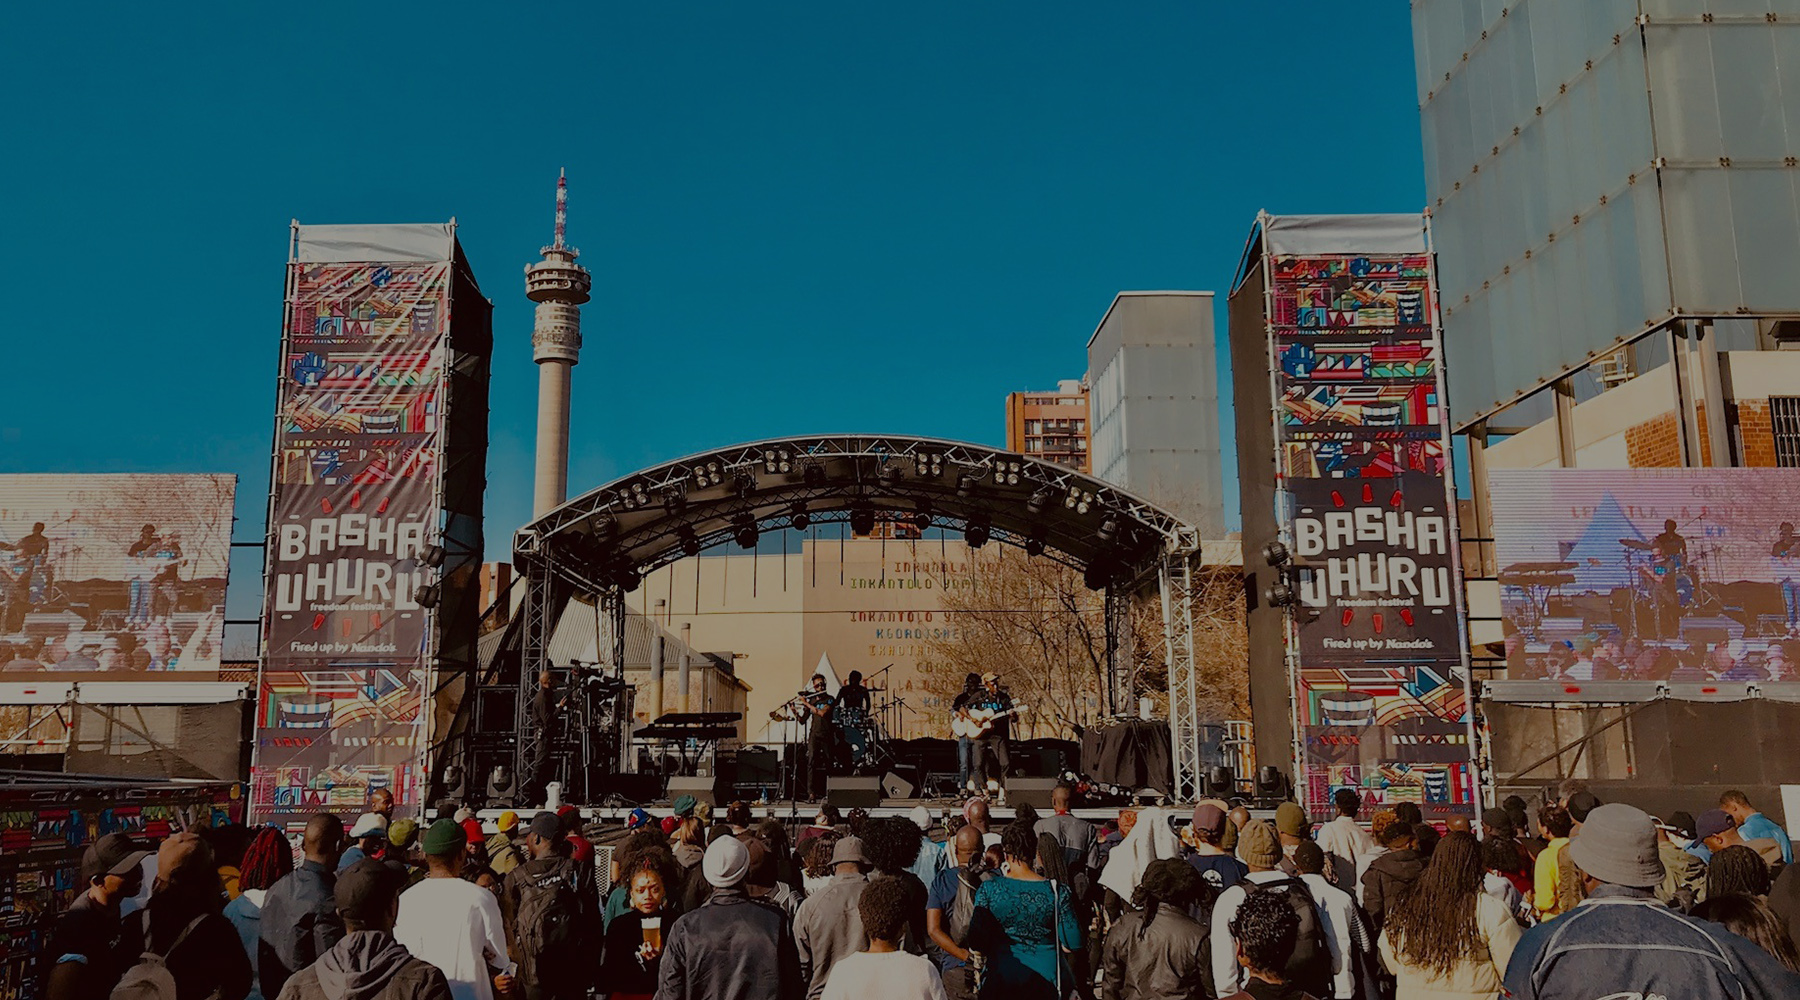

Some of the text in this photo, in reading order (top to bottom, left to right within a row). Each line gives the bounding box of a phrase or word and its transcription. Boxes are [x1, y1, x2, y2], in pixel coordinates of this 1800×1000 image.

[278, 513, 424, 561] BASHA
[1295, 506, 1446, 556] BASHA
[275, 558, 422, 611] UHURU
[1300, 552, 1450, 608] UHURU
[310, 601, 386, 611] freedom festival
[1336, 597, 1377, 607] freedom
[850, 611, 933, 622] INKANTOLO
[290, 641, 318, 653] Fired
[318, 642, 334, 654] up
[335, 641, 349, 654] by
[1323, 637, 1352, 649] Fired
[1353, 639, 1368, 650] up
[1369, 637, 1383, 650] by
